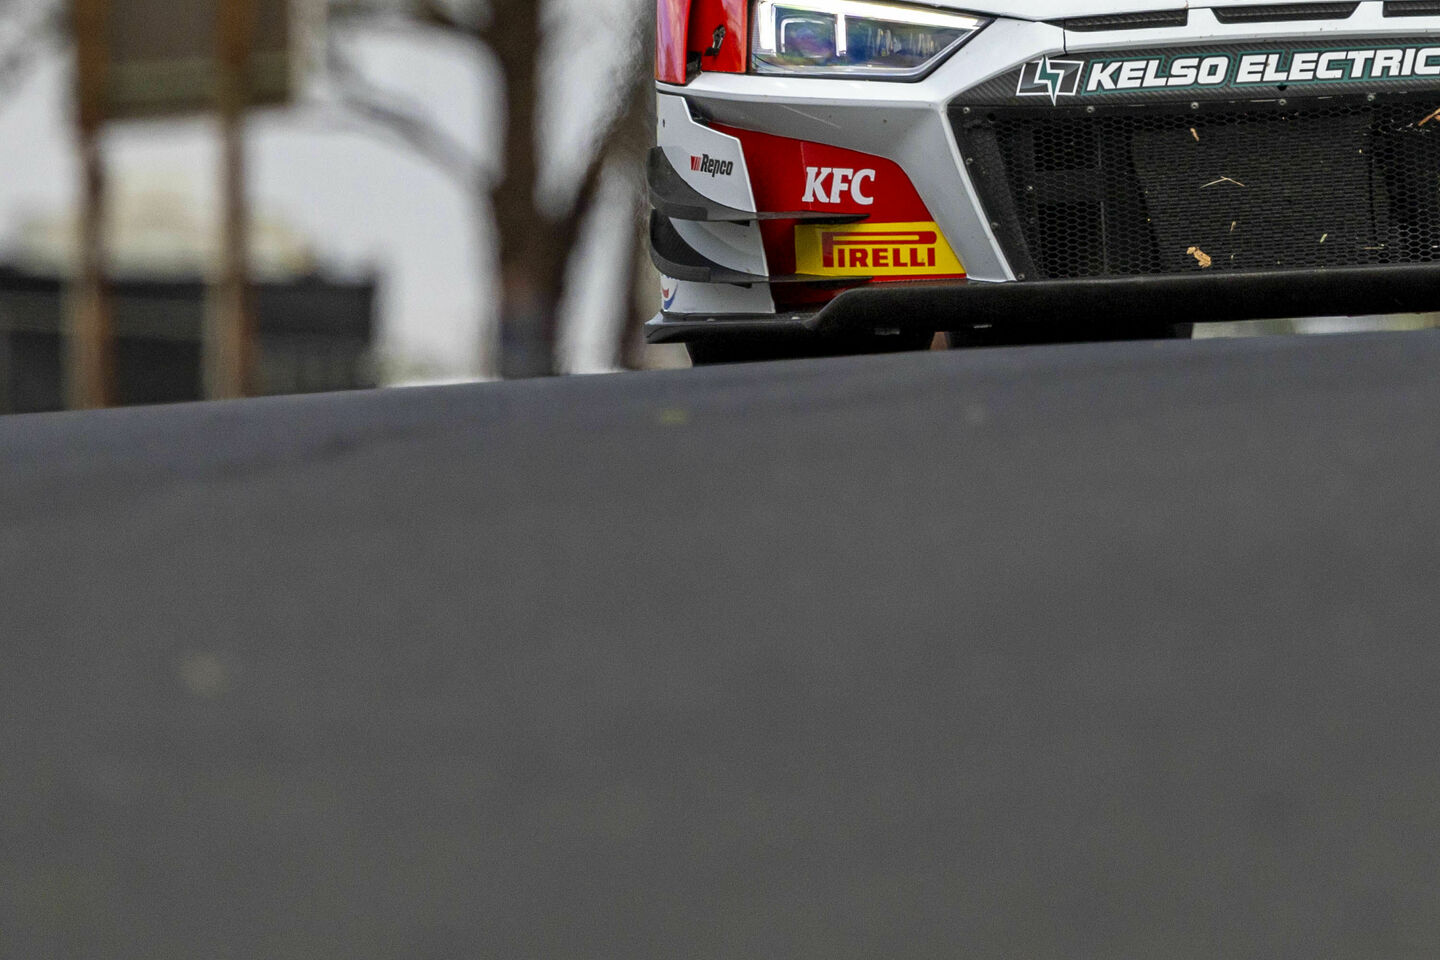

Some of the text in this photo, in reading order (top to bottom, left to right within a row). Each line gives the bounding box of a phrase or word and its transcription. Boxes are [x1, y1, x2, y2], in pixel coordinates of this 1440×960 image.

[1086, 55, 1229, 91] KELSO
[700, 154, 734, 177] Repco
[801, 166, 876, 205] KFC
[821, 231, 937, 267] PIRELLI
